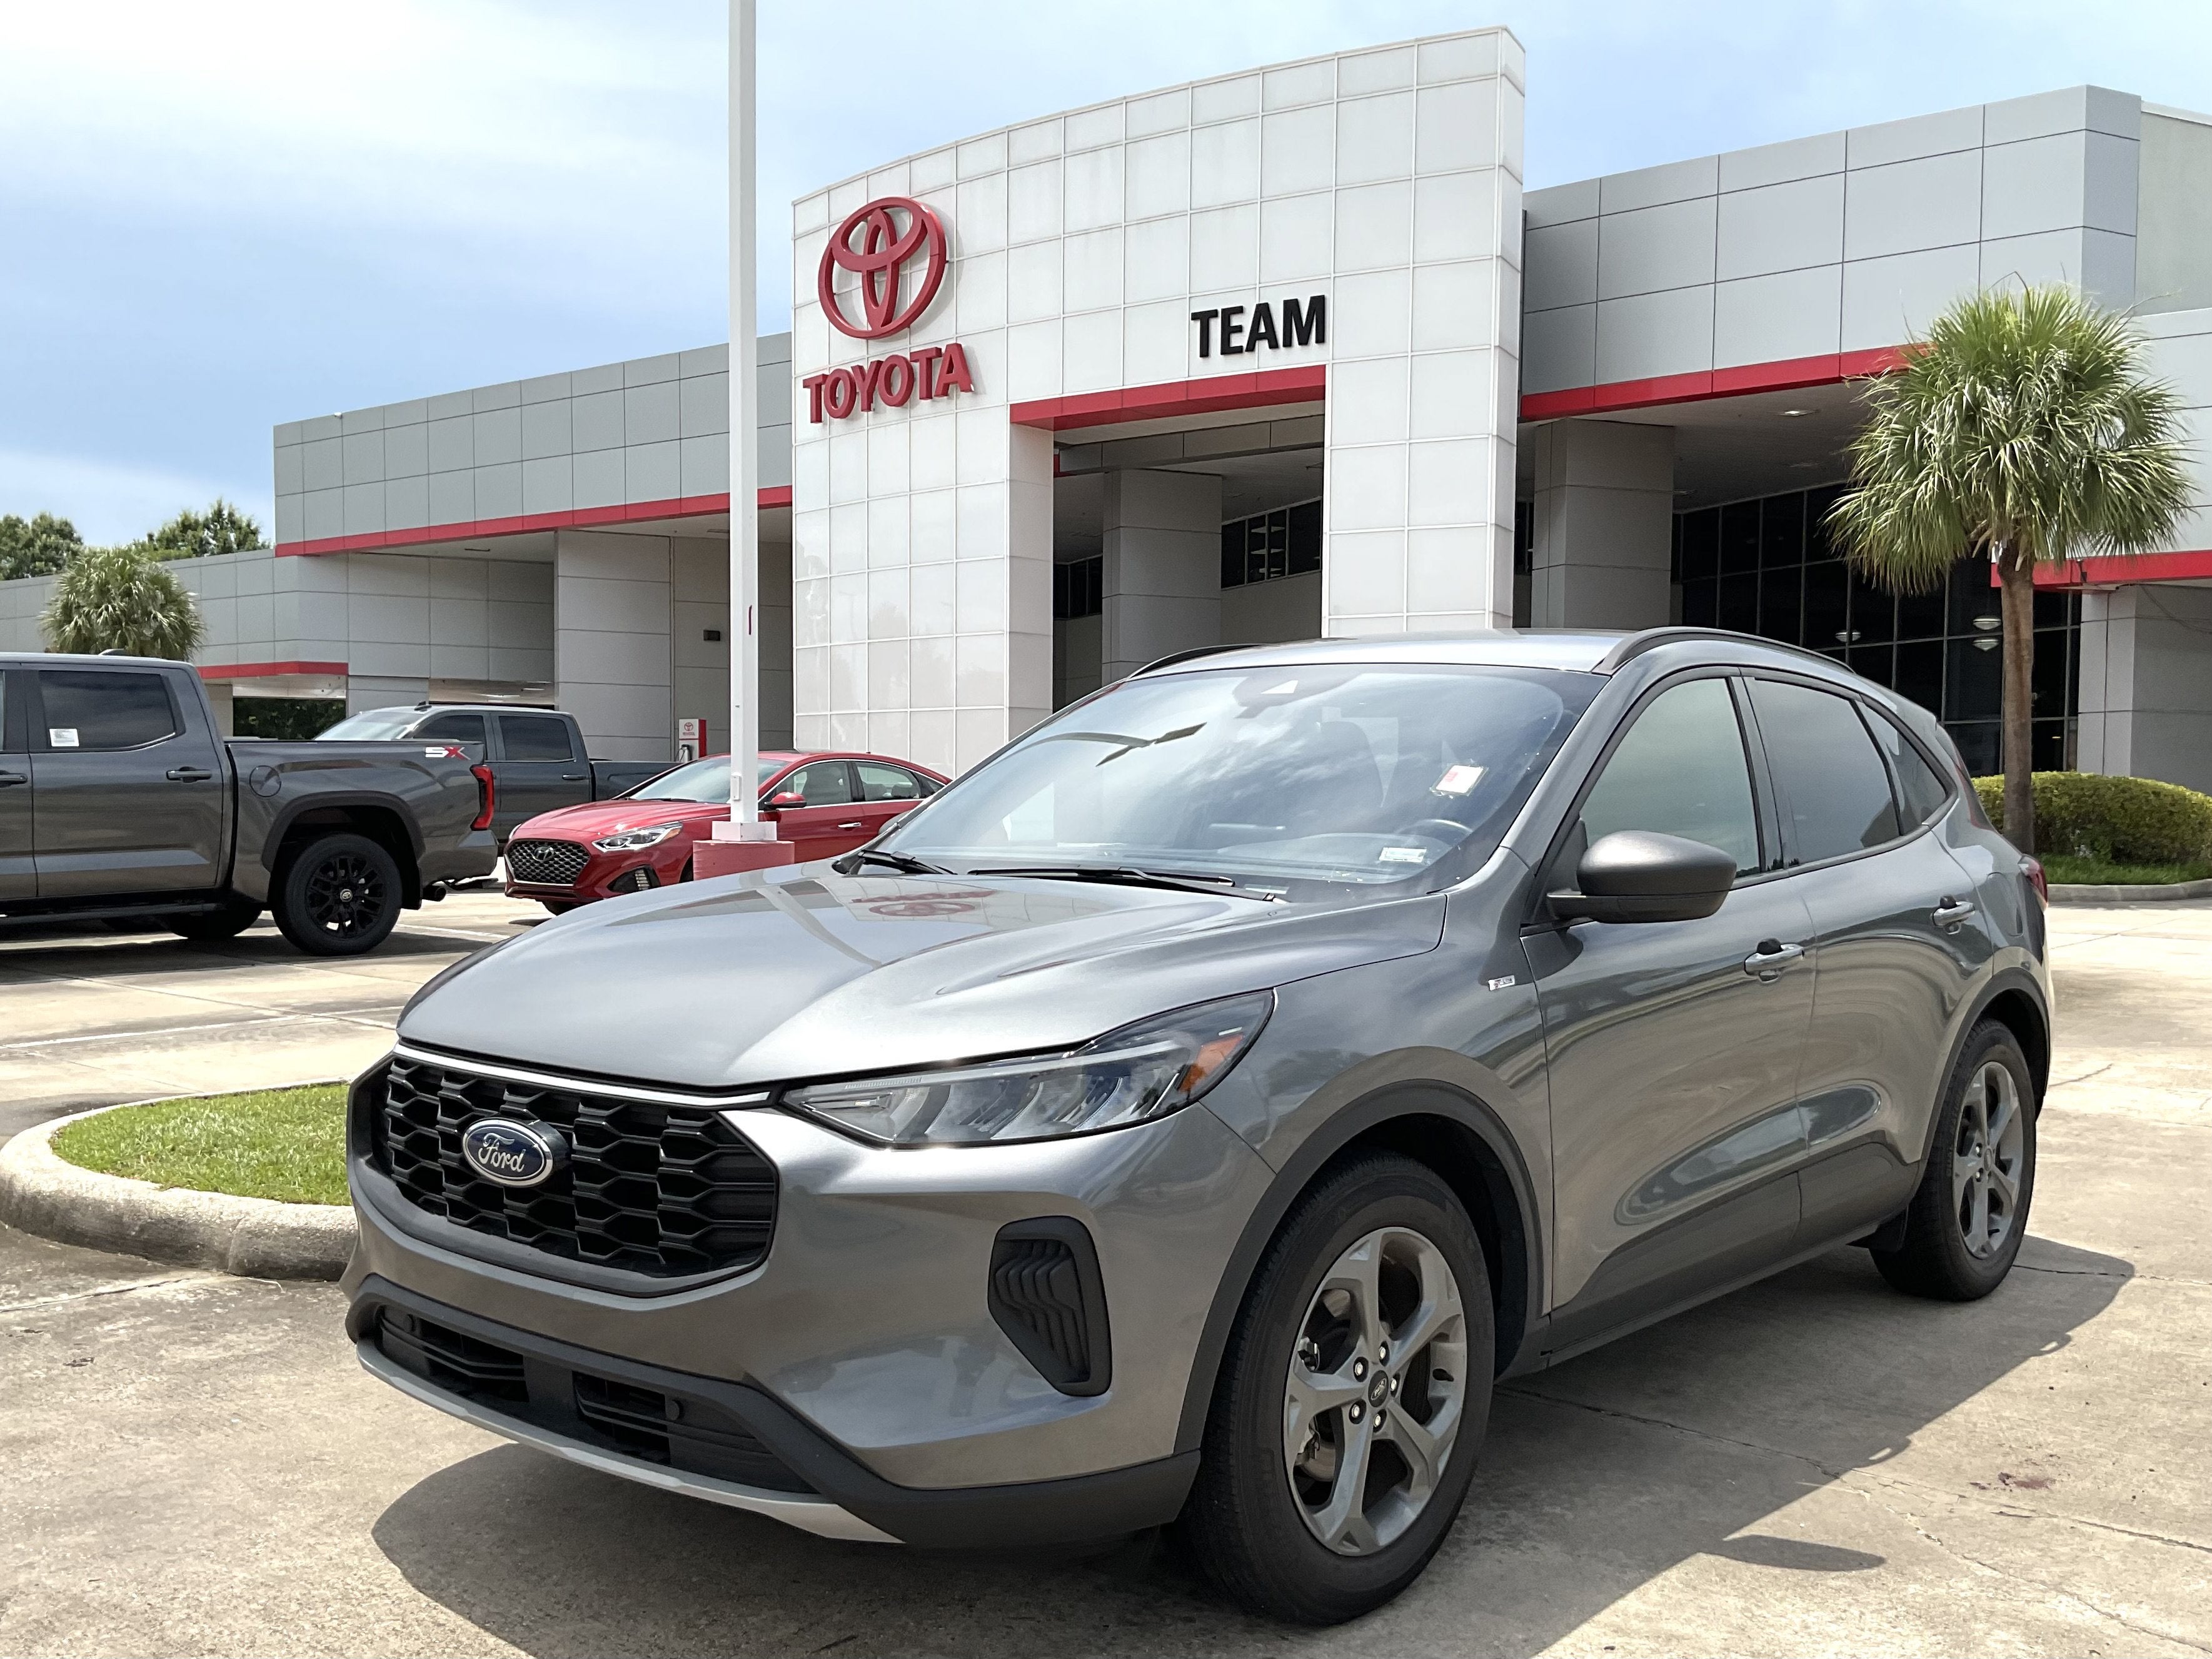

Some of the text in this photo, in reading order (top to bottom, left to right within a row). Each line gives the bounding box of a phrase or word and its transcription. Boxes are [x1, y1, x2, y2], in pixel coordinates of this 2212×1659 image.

[1191, 295, 1325, 358] TEAM
[803, 343, 974, 423] TOYOTA
[425, 746, 471, 760] SX
[478, 1132, 526, 1172] Ford
